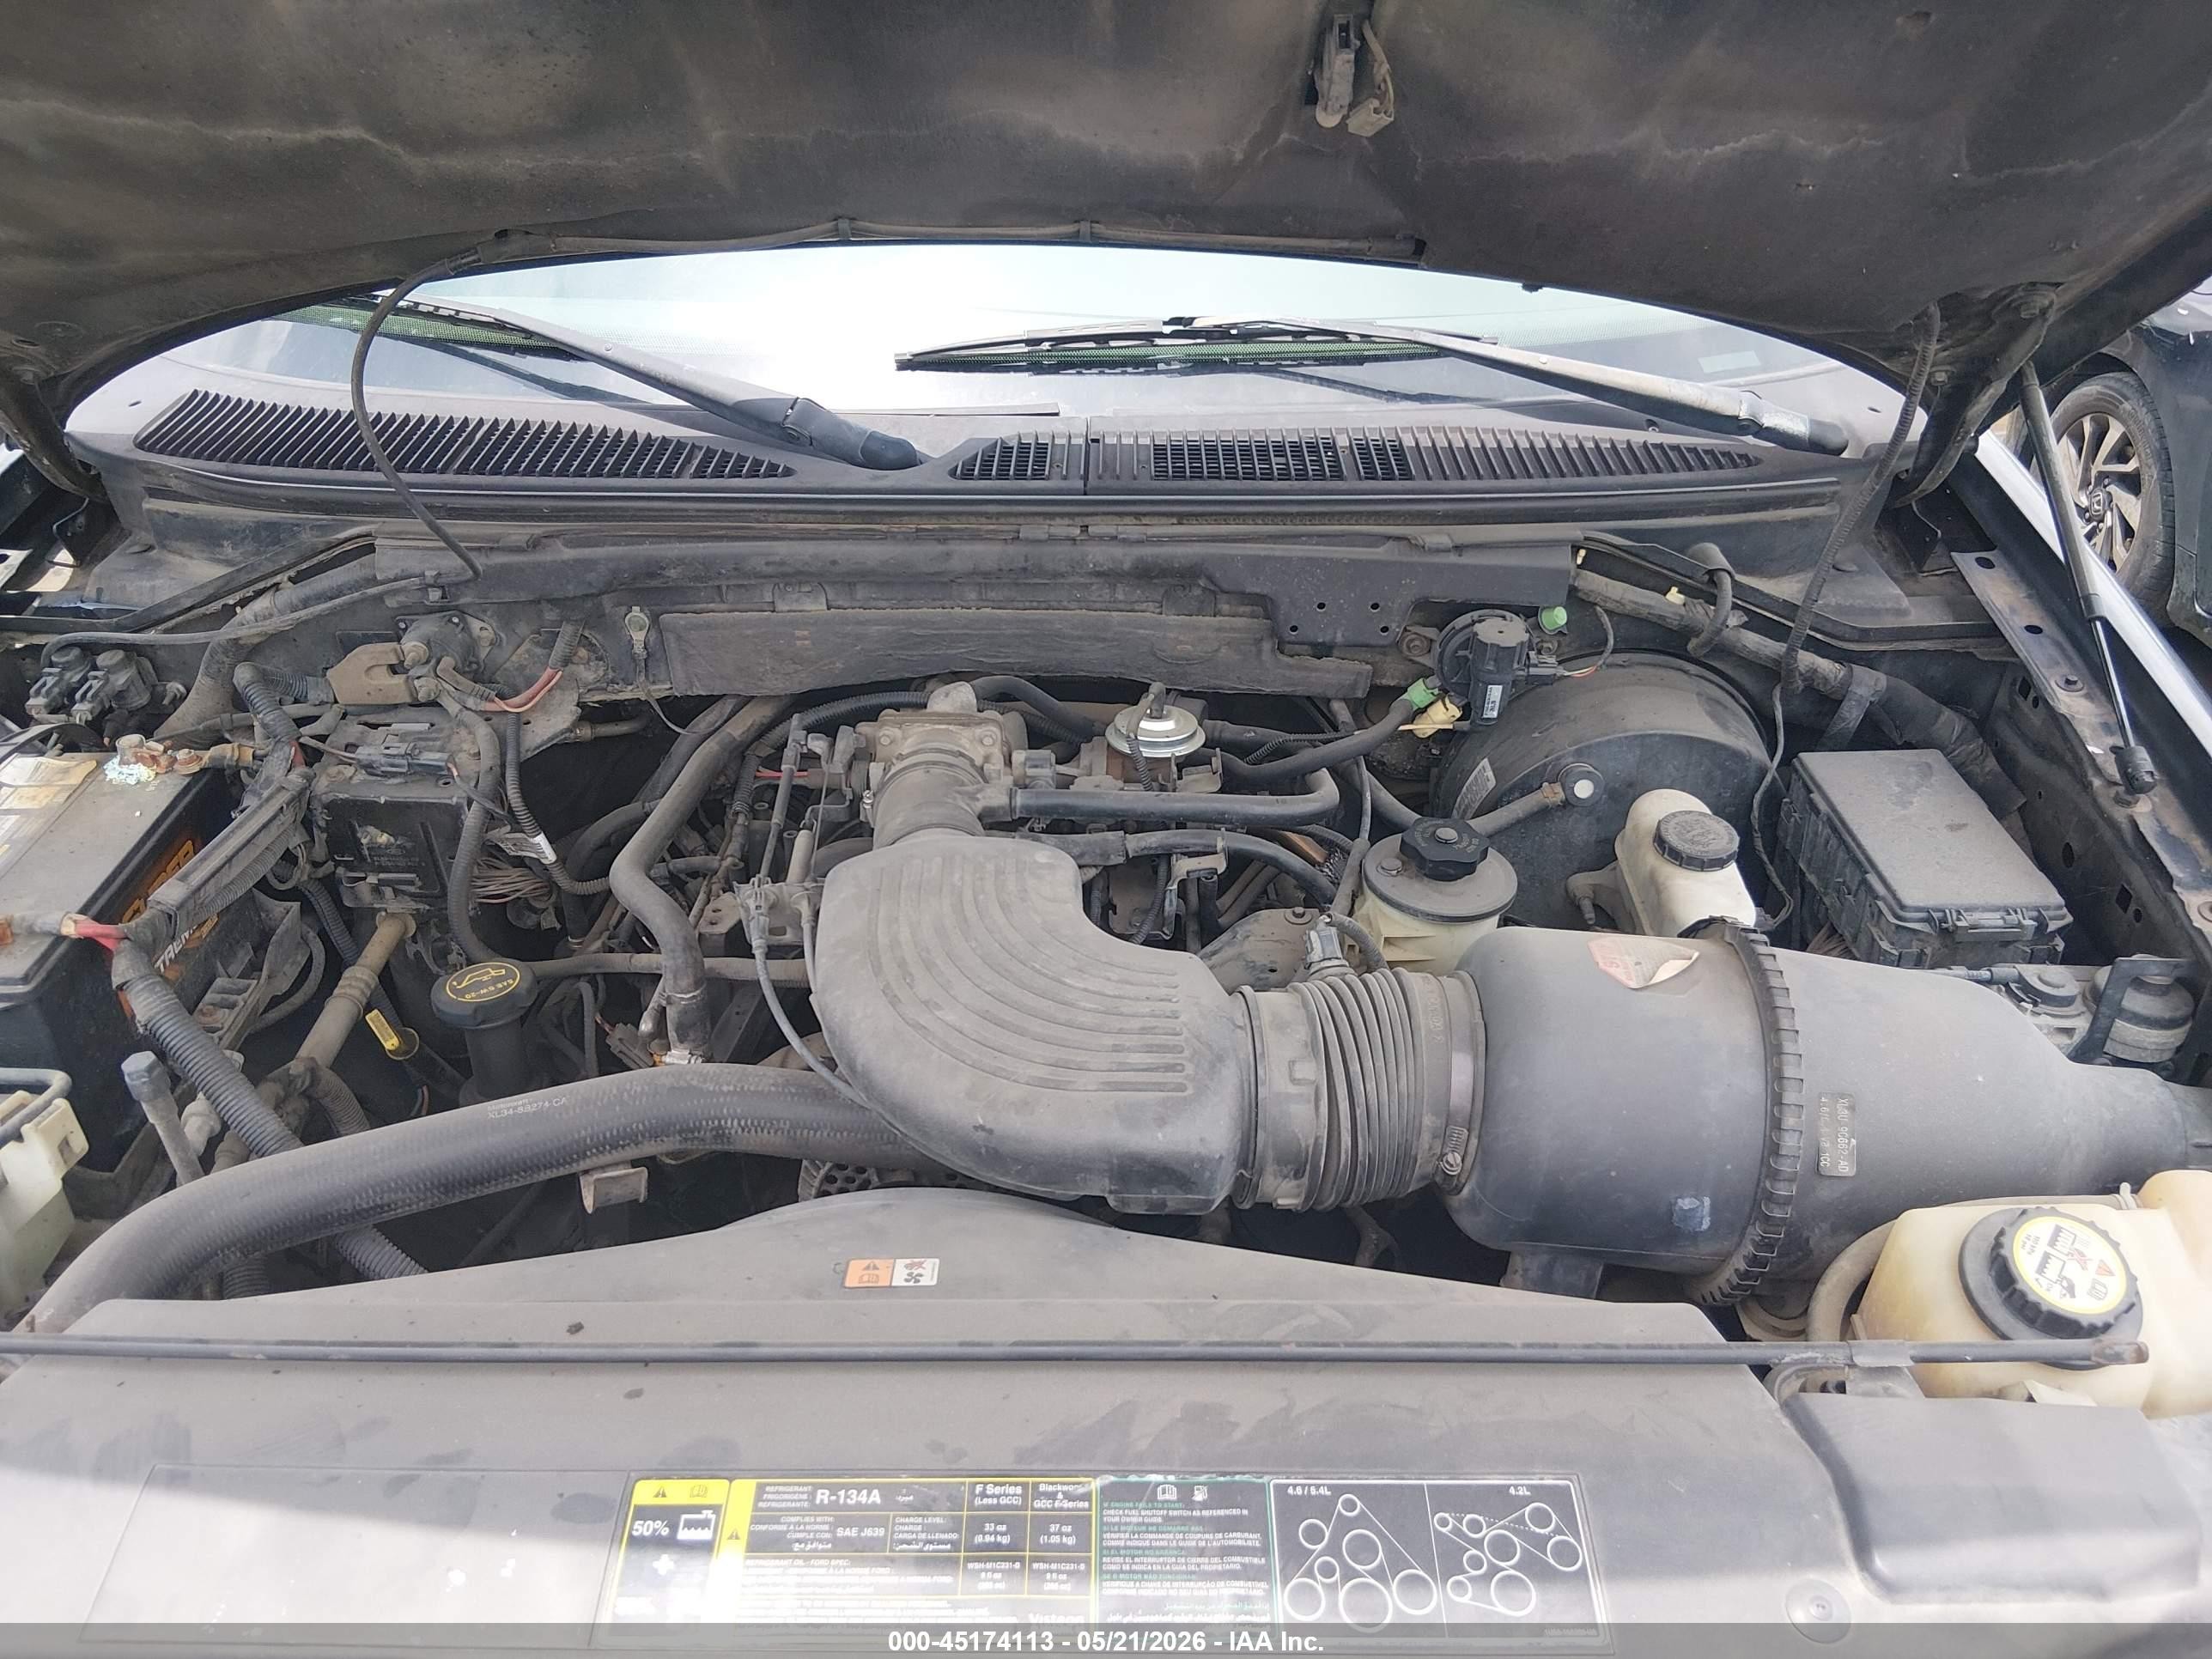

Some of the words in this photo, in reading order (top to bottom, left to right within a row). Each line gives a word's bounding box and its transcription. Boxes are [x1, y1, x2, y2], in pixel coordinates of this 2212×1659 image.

[495, 978, 514, 989] SAE
[975, 1484, 984, 1494] F
[986, 1484, 1023, 1495] Series
[1287, 1486, 1303, 1496] 4.6
[1509, 1486, 1531, 1496] 4.2L
[815, 1489, 882, 1504] R-134A
[974, 1496, 998, 1506] (Less
[1000, 1496, 1023, 1506] GCC)
[631, 1520, 670, 1537] 50%
[836, 1527, 859, 1537] SAE
[860, 1527, 885, 1537] J639
[984, 1522, 994, 1532] 33
[995, 1523, 1007, 1532] oz
[1049, 1523, 1060, 1533] 37
[1061, 1524, 1073, 1533] oz
[996, 1534, 1011, 1544] kg)
[1040, 1534, 1061, 1545] (1.05
[1062, 1534, 1076, 1545] kg)
